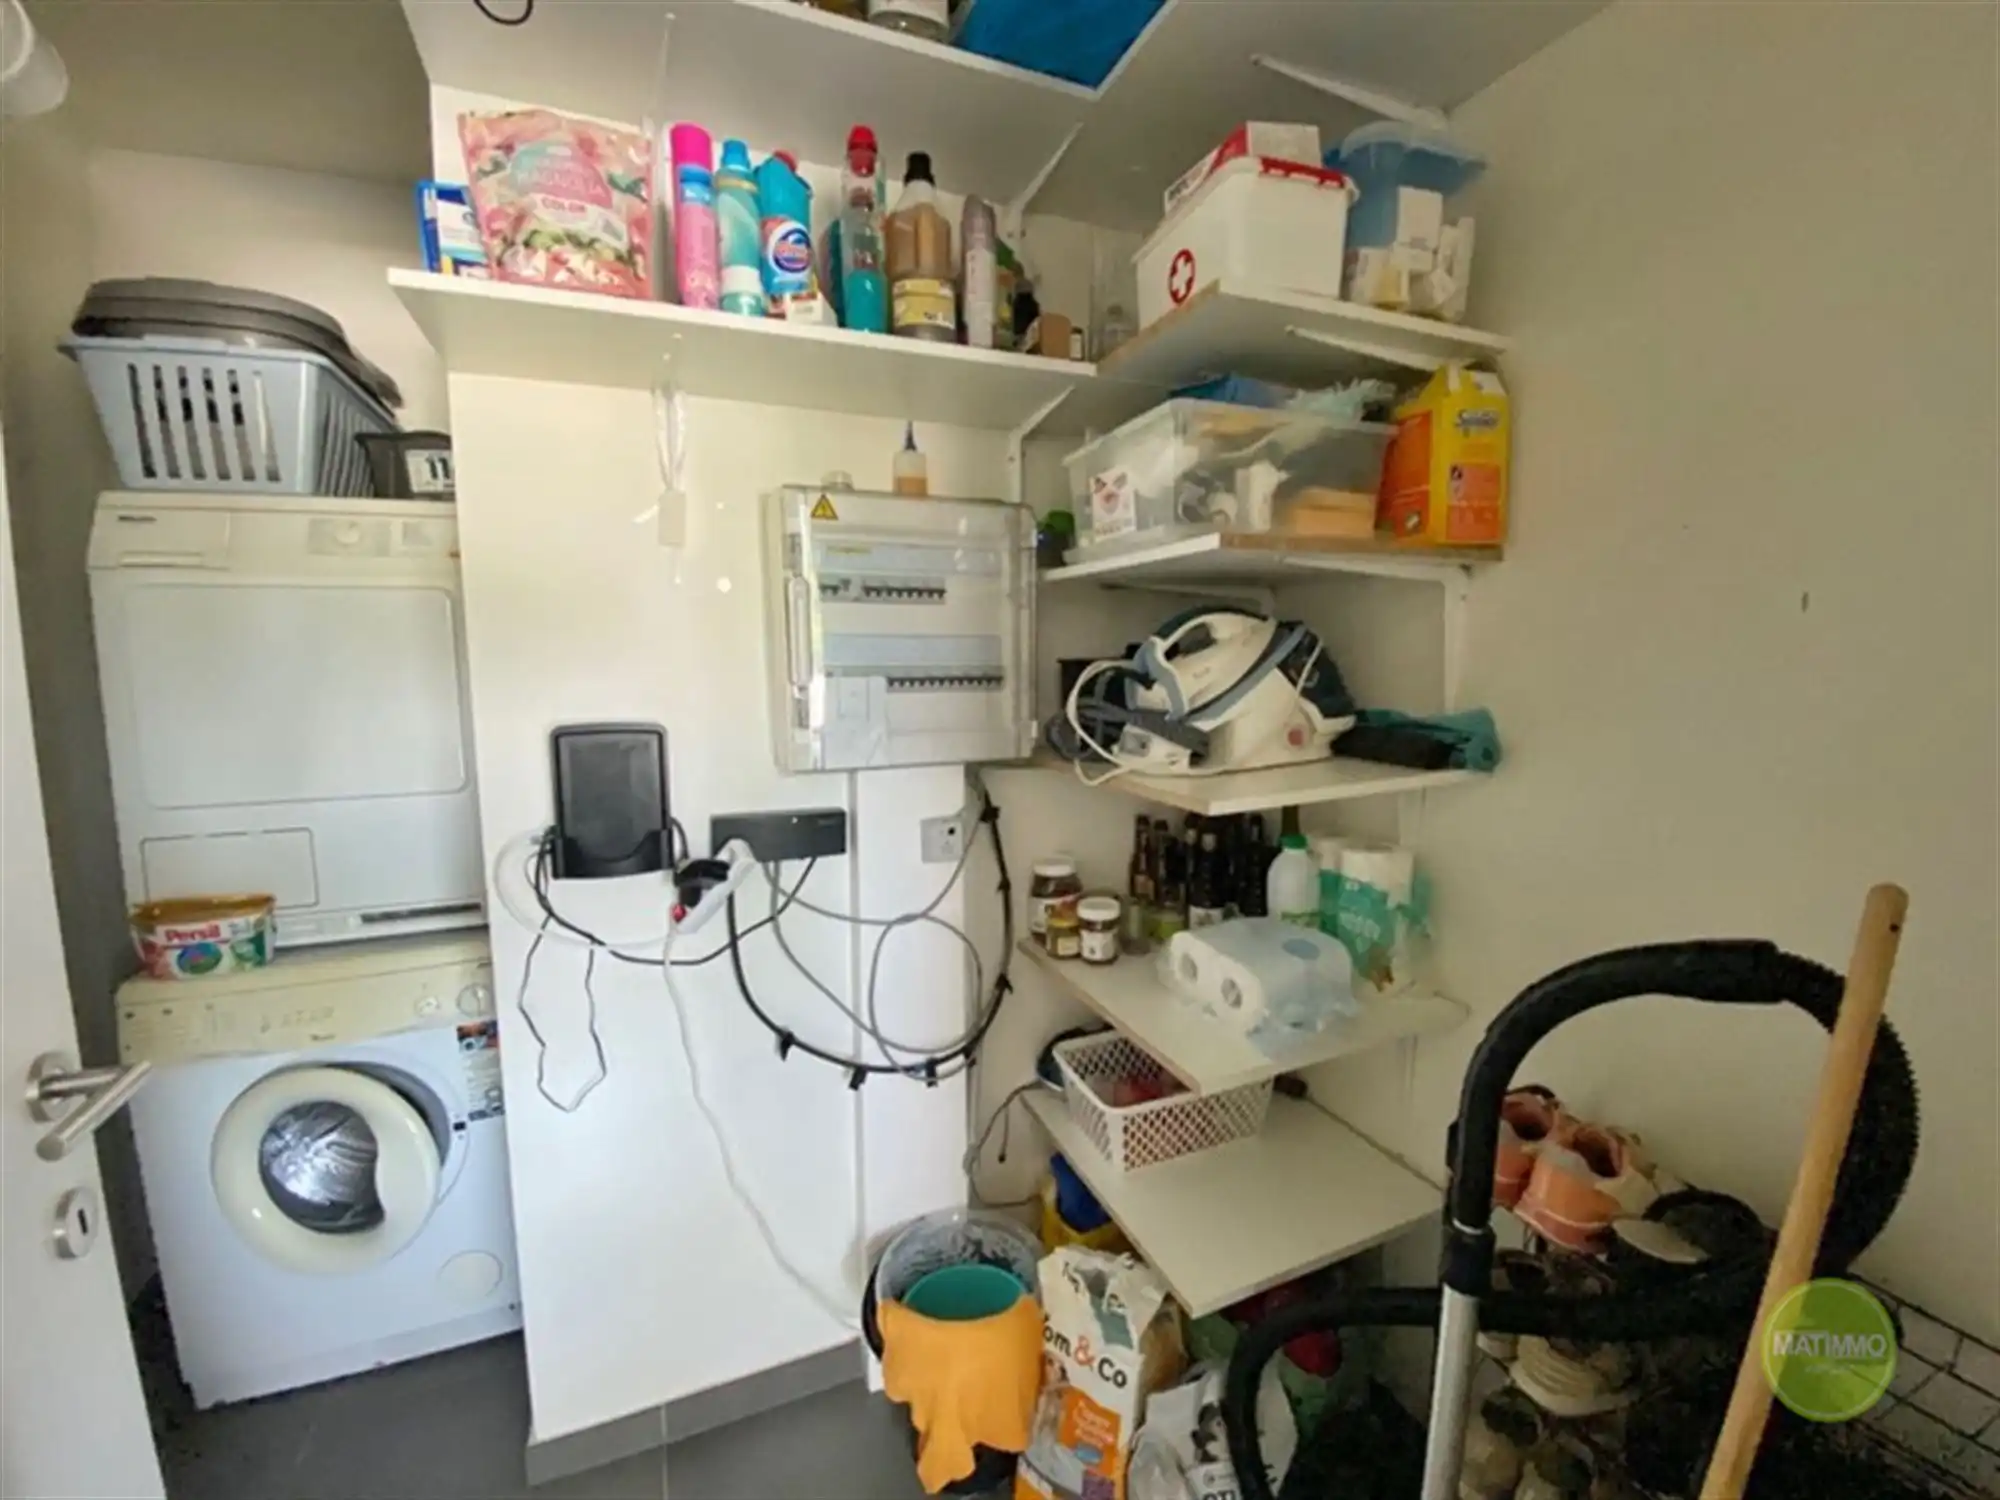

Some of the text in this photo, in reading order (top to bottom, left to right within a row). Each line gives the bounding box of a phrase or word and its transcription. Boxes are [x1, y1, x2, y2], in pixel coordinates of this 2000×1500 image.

[541, 196, 587, 214] COLOR
[164, 923, 221, 943] Persil
[1042, 1313, 1128, 1390] om & Co
